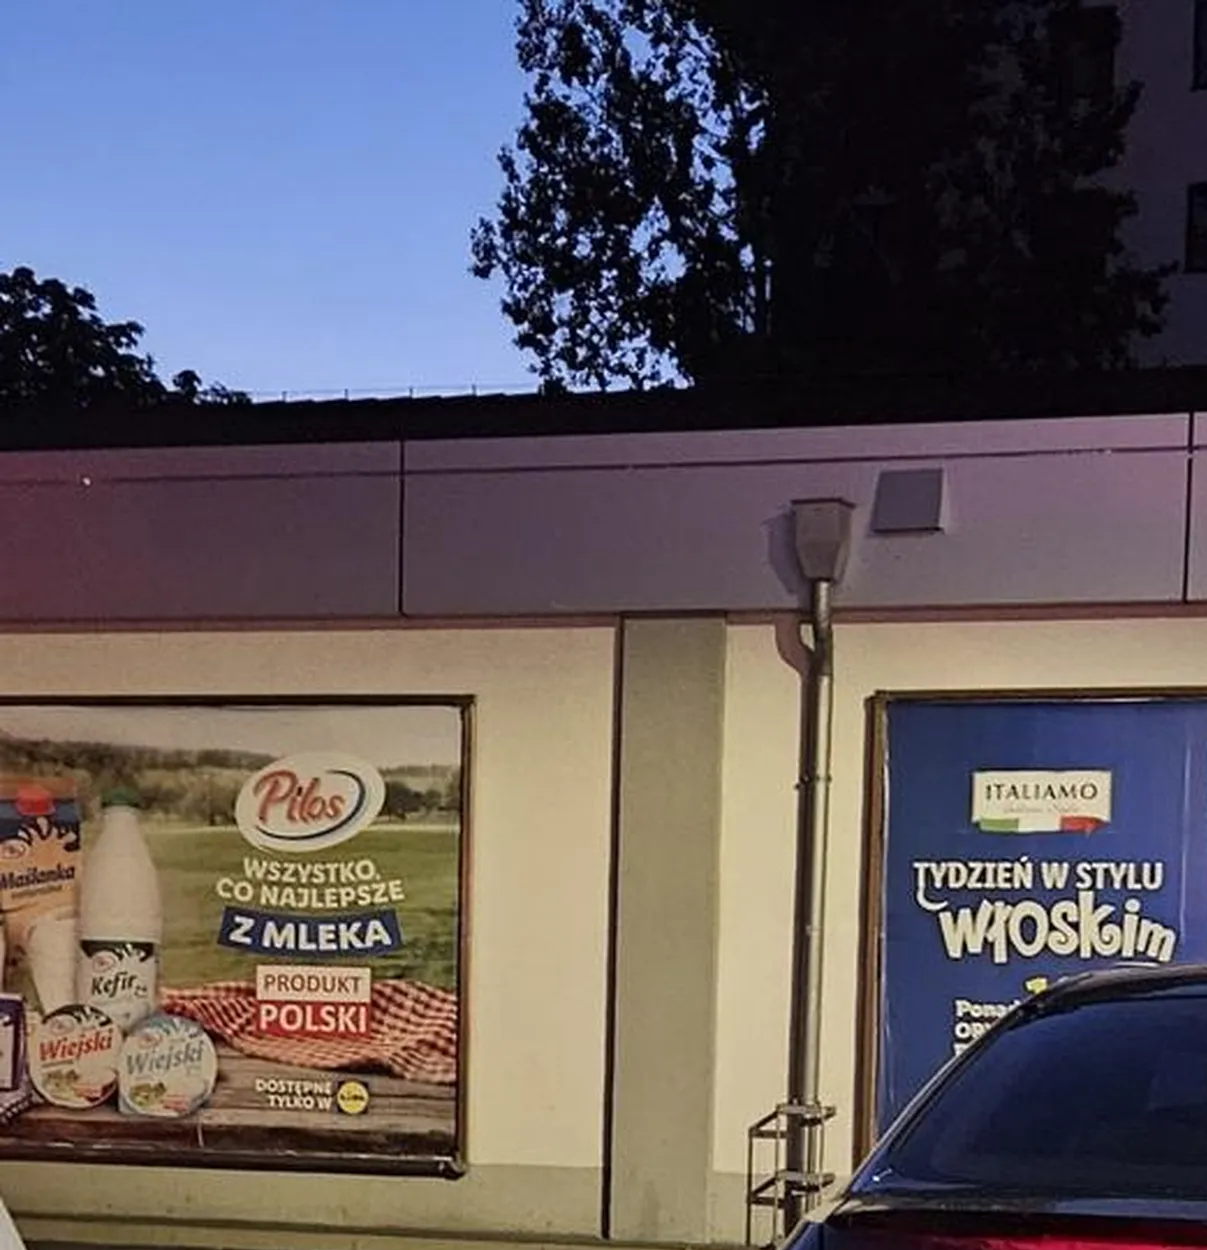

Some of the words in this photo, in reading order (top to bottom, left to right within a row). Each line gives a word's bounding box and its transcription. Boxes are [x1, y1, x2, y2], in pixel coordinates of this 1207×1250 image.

[253, 770, 345, 825] Pilos
[985, 783, 1098, 800] ITALIAMO
[216, 878, 254, 902] CO
[260, 880, 405, 909] NAJLEPSZE
[913, 856, 1033, 911] TYDZIEŃ
[1041, 862, 1070, 890] W
[1076, 862, 1163, 890] STYLU
[229, 915, 256, 944] Z
[261, 919, 392, 951] MLEKA
[91, 971, 137, 998] Kefir
[264, 974, 362, 994] PRODUKT
[260, 1004, 367, 1033] POLSKI
[39, 1028, 113, 1062] Wiejski
[126, 1041, 203, 1075] Wiejski
